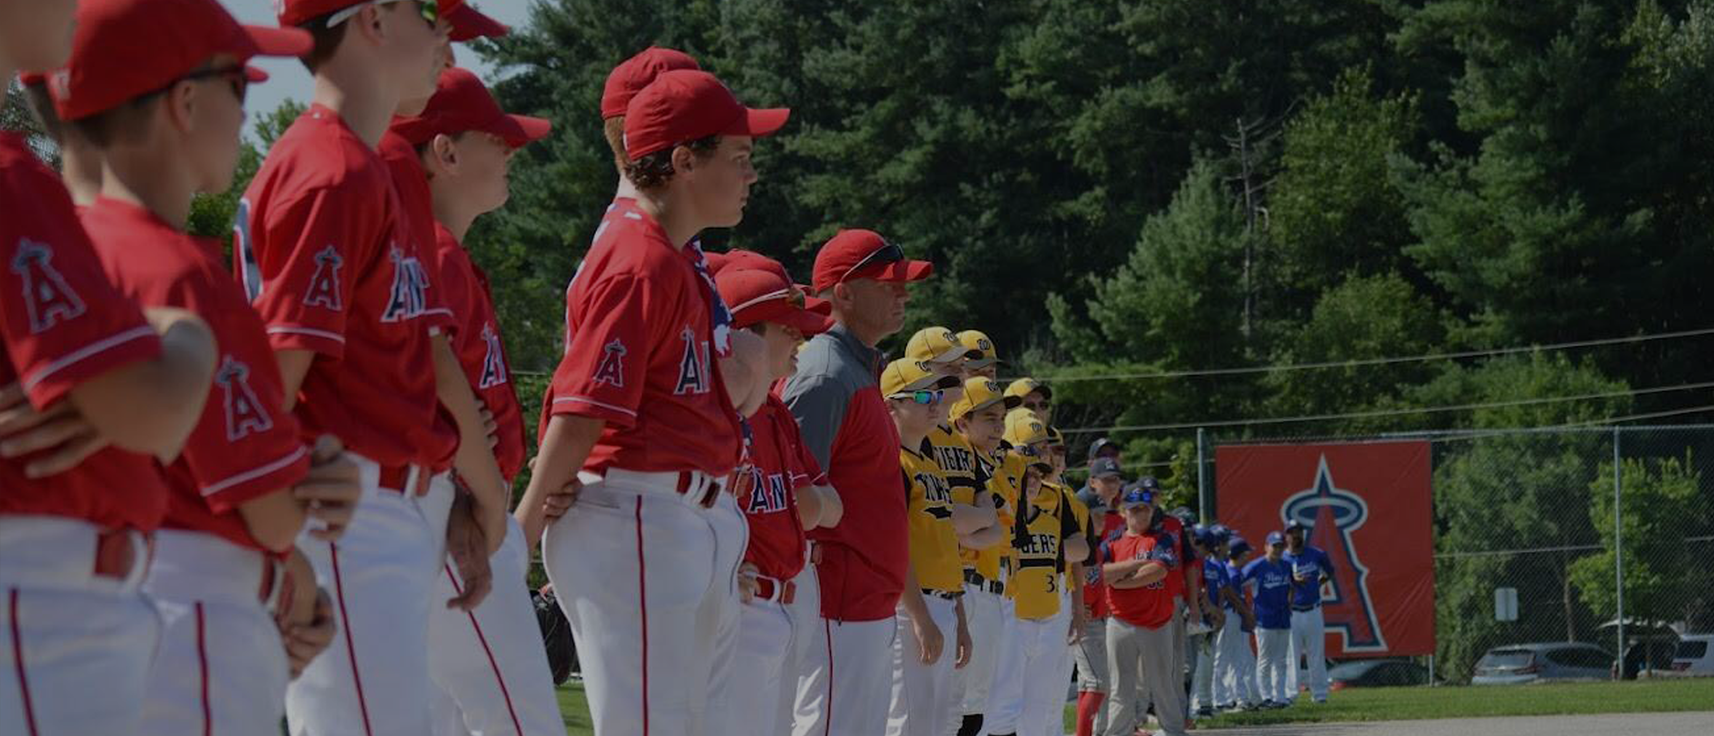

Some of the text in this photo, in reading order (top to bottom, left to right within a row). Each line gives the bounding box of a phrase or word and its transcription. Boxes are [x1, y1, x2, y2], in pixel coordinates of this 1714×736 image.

[11, 237, 86, 334] A
[303, 245, 343, 312] A
[215, 354, 273, 441] A
[593, 337, 627, 387] A
[1281, 452, 1389, 652] A
